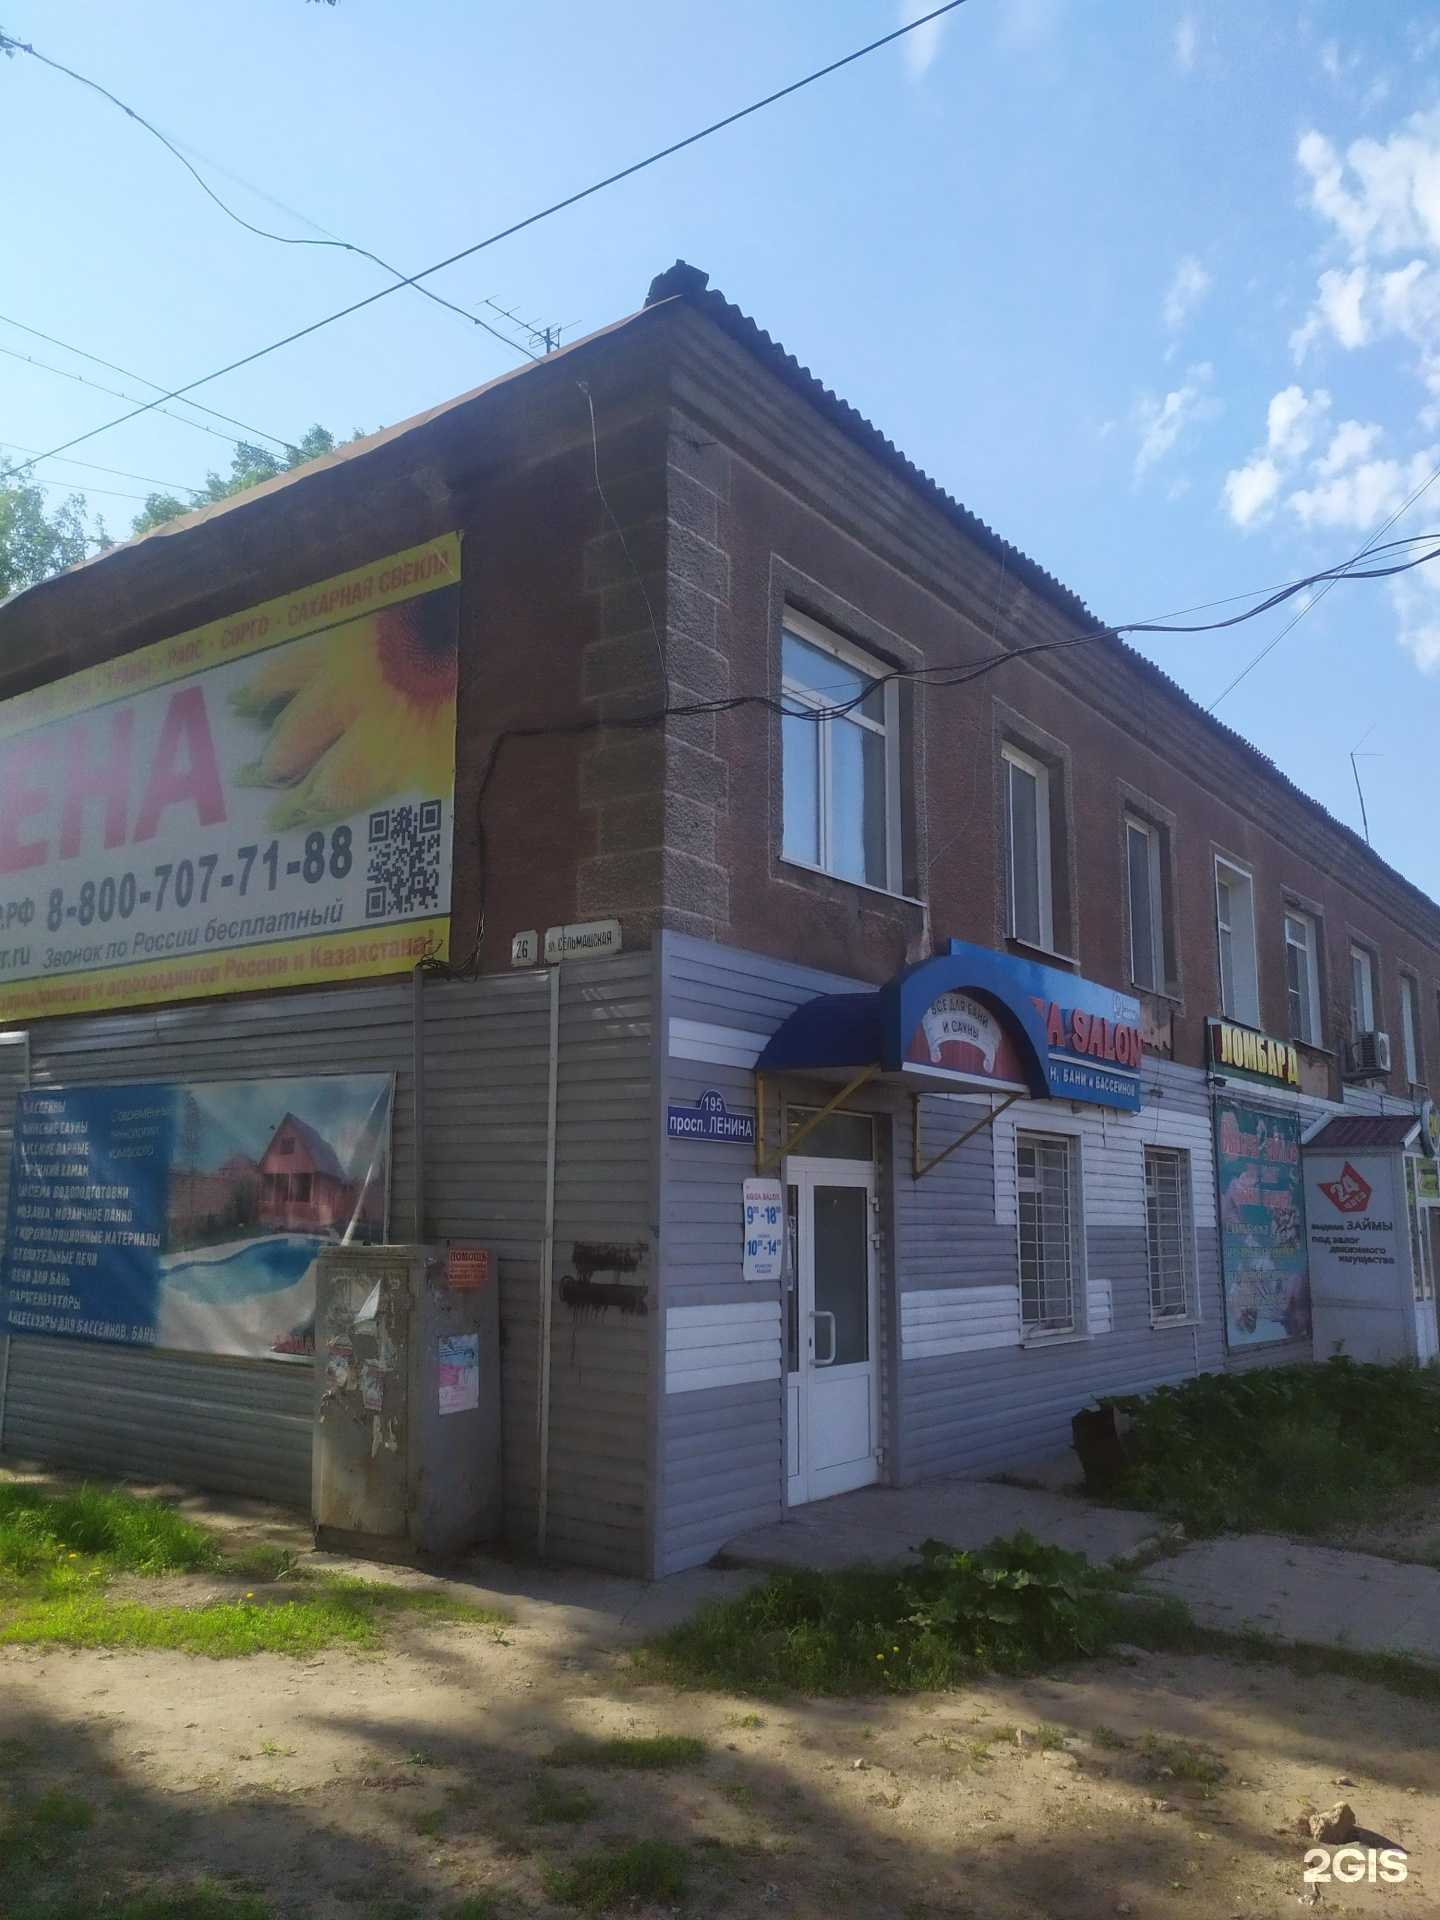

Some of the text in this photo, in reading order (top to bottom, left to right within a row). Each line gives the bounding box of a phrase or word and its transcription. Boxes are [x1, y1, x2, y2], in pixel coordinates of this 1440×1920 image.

[47, 825, 353, 932] 8-800-707-71-88
[43, 898, 344, 969] Звонок по России бесплатный
[516, 939, 529, 959] 26
[951, 1020, 978, 1039] САУНЫ
[1072, 1008, 1142, 1068] SALON
[1063, 1069, 1086, 1087] БАНИ
[704, 1096, 722, 1112] 195
[669, 1116, 752, 1137] просп. ЛЕНИНА
[1346, 1218, 1392, 1232] ЗАЙМЫ
